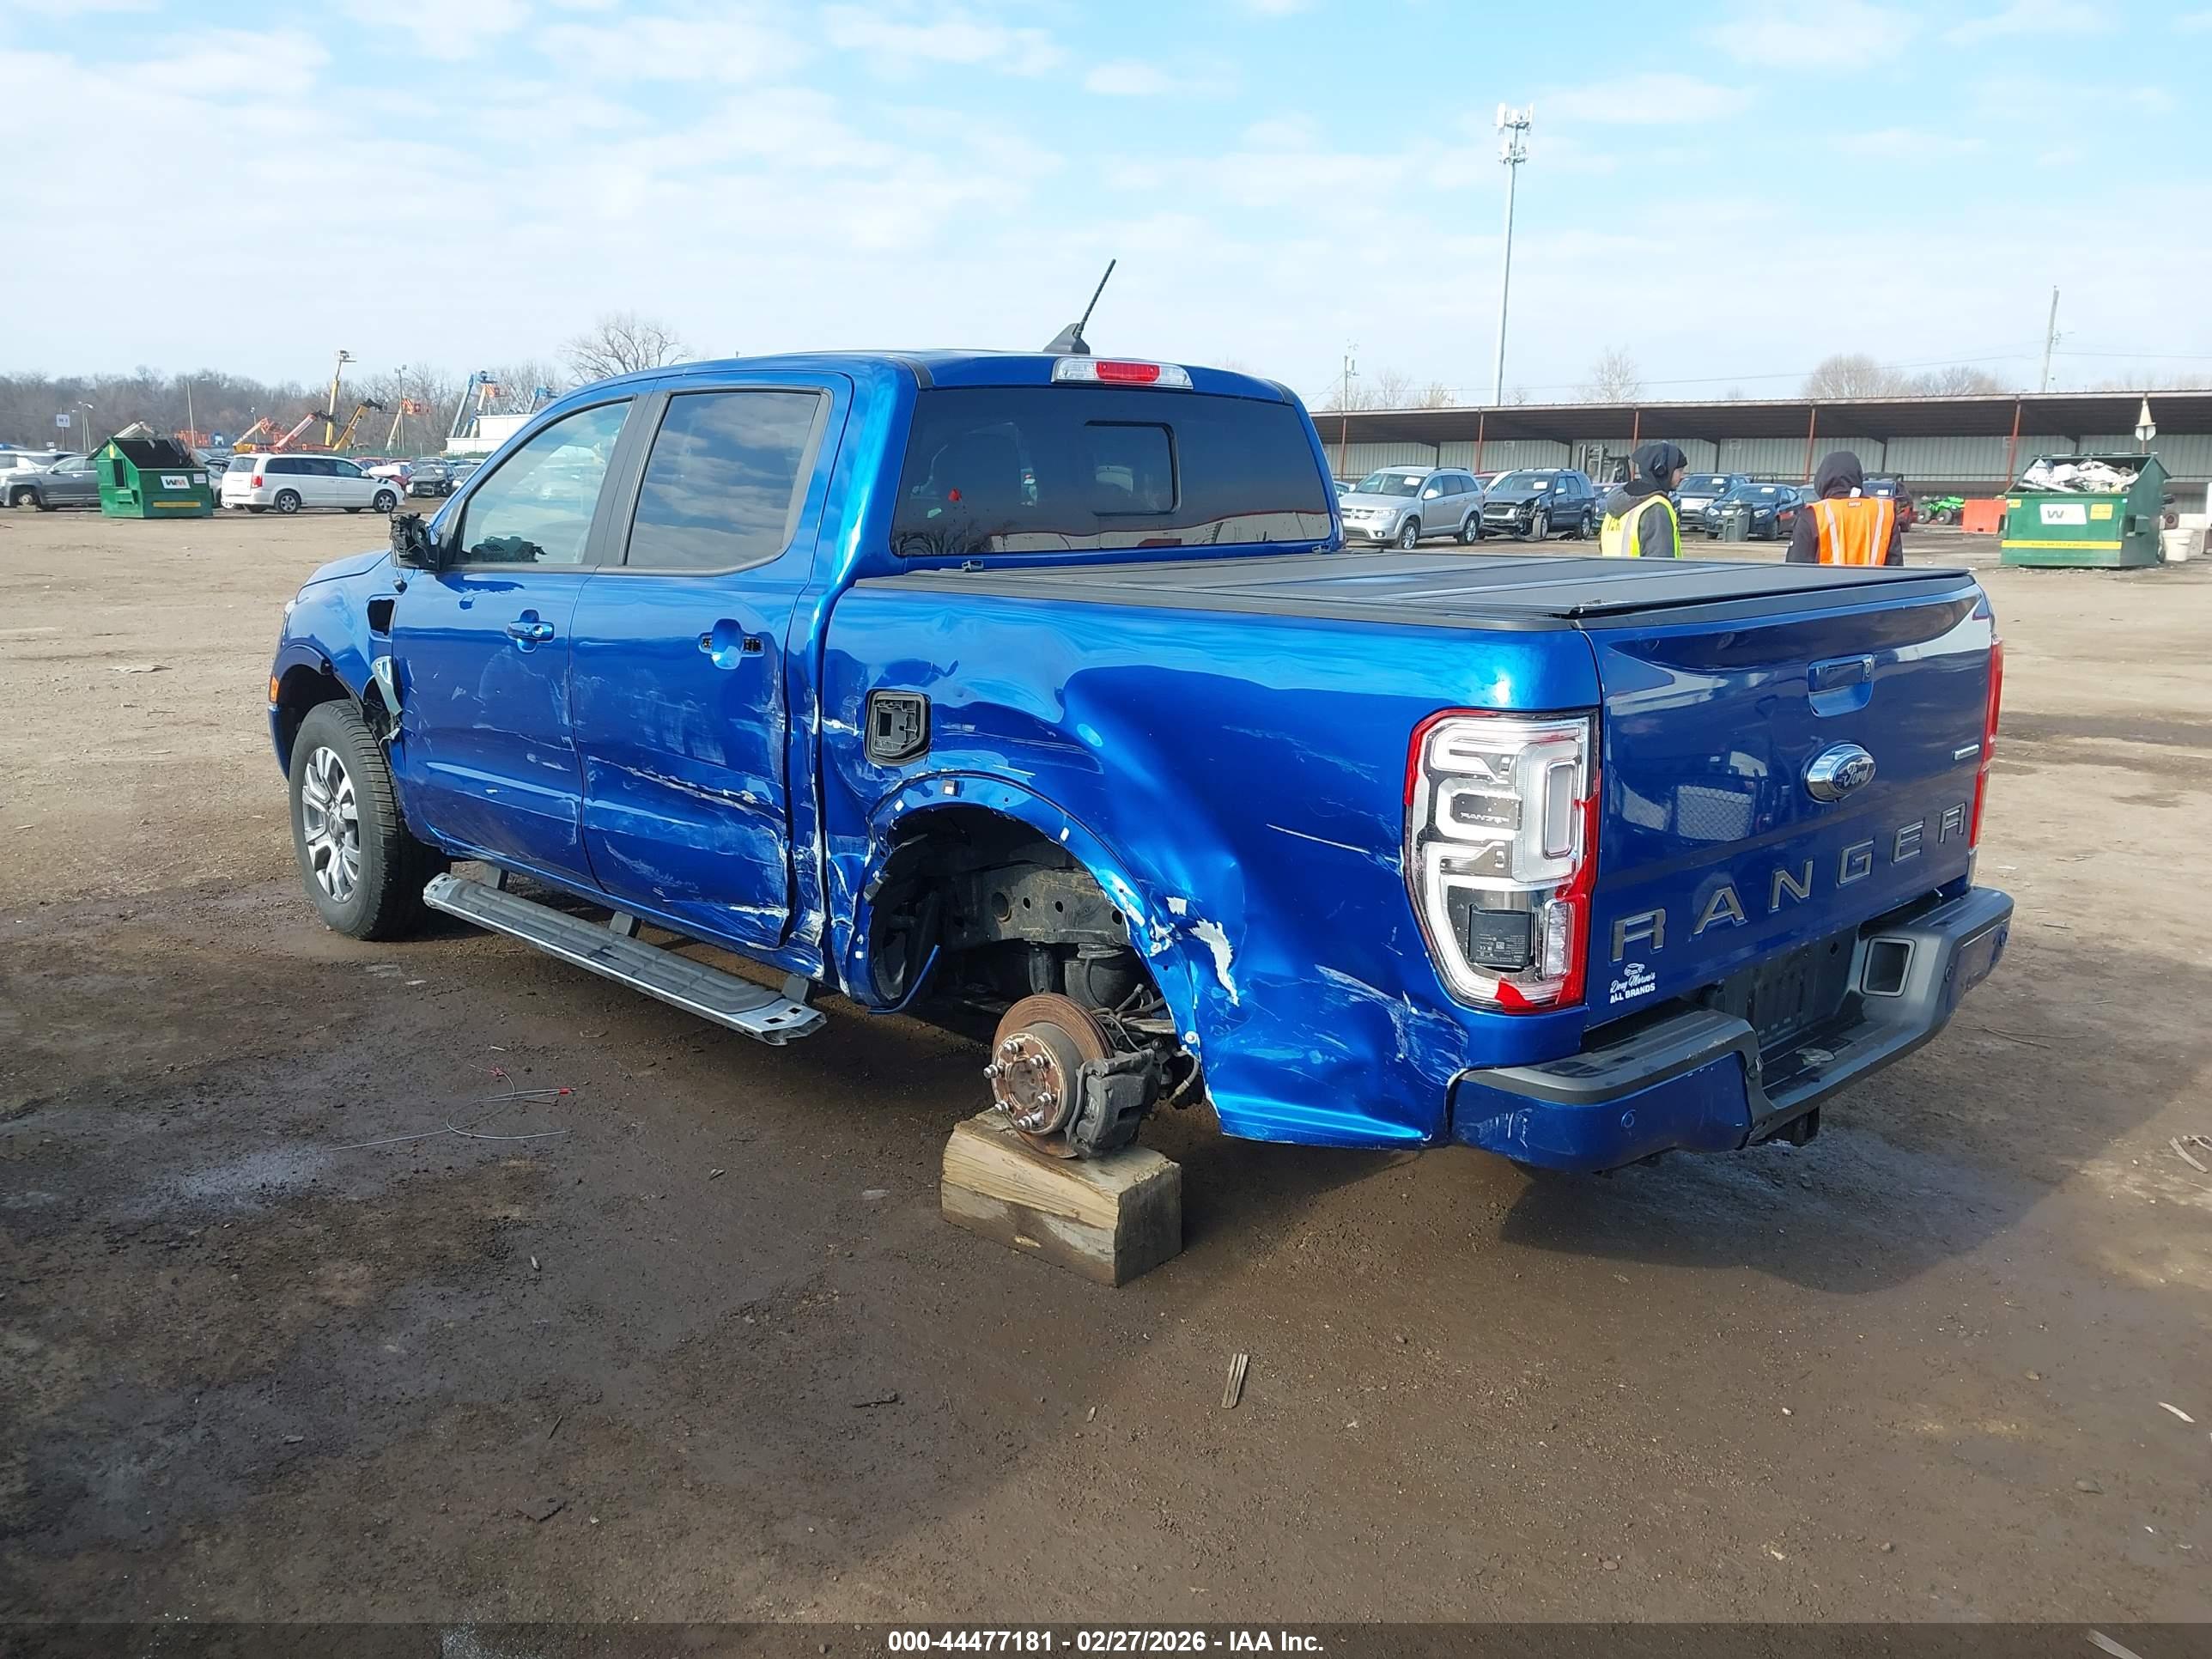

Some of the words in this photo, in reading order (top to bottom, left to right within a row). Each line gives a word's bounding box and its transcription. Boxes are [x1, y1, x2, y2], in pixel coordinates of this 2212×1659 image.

[1608, 802, 1966, 967] RANGER
[1610, 992, 1624, 1004] ALL
[1625, 982, 1656, 1000] BRANDS
